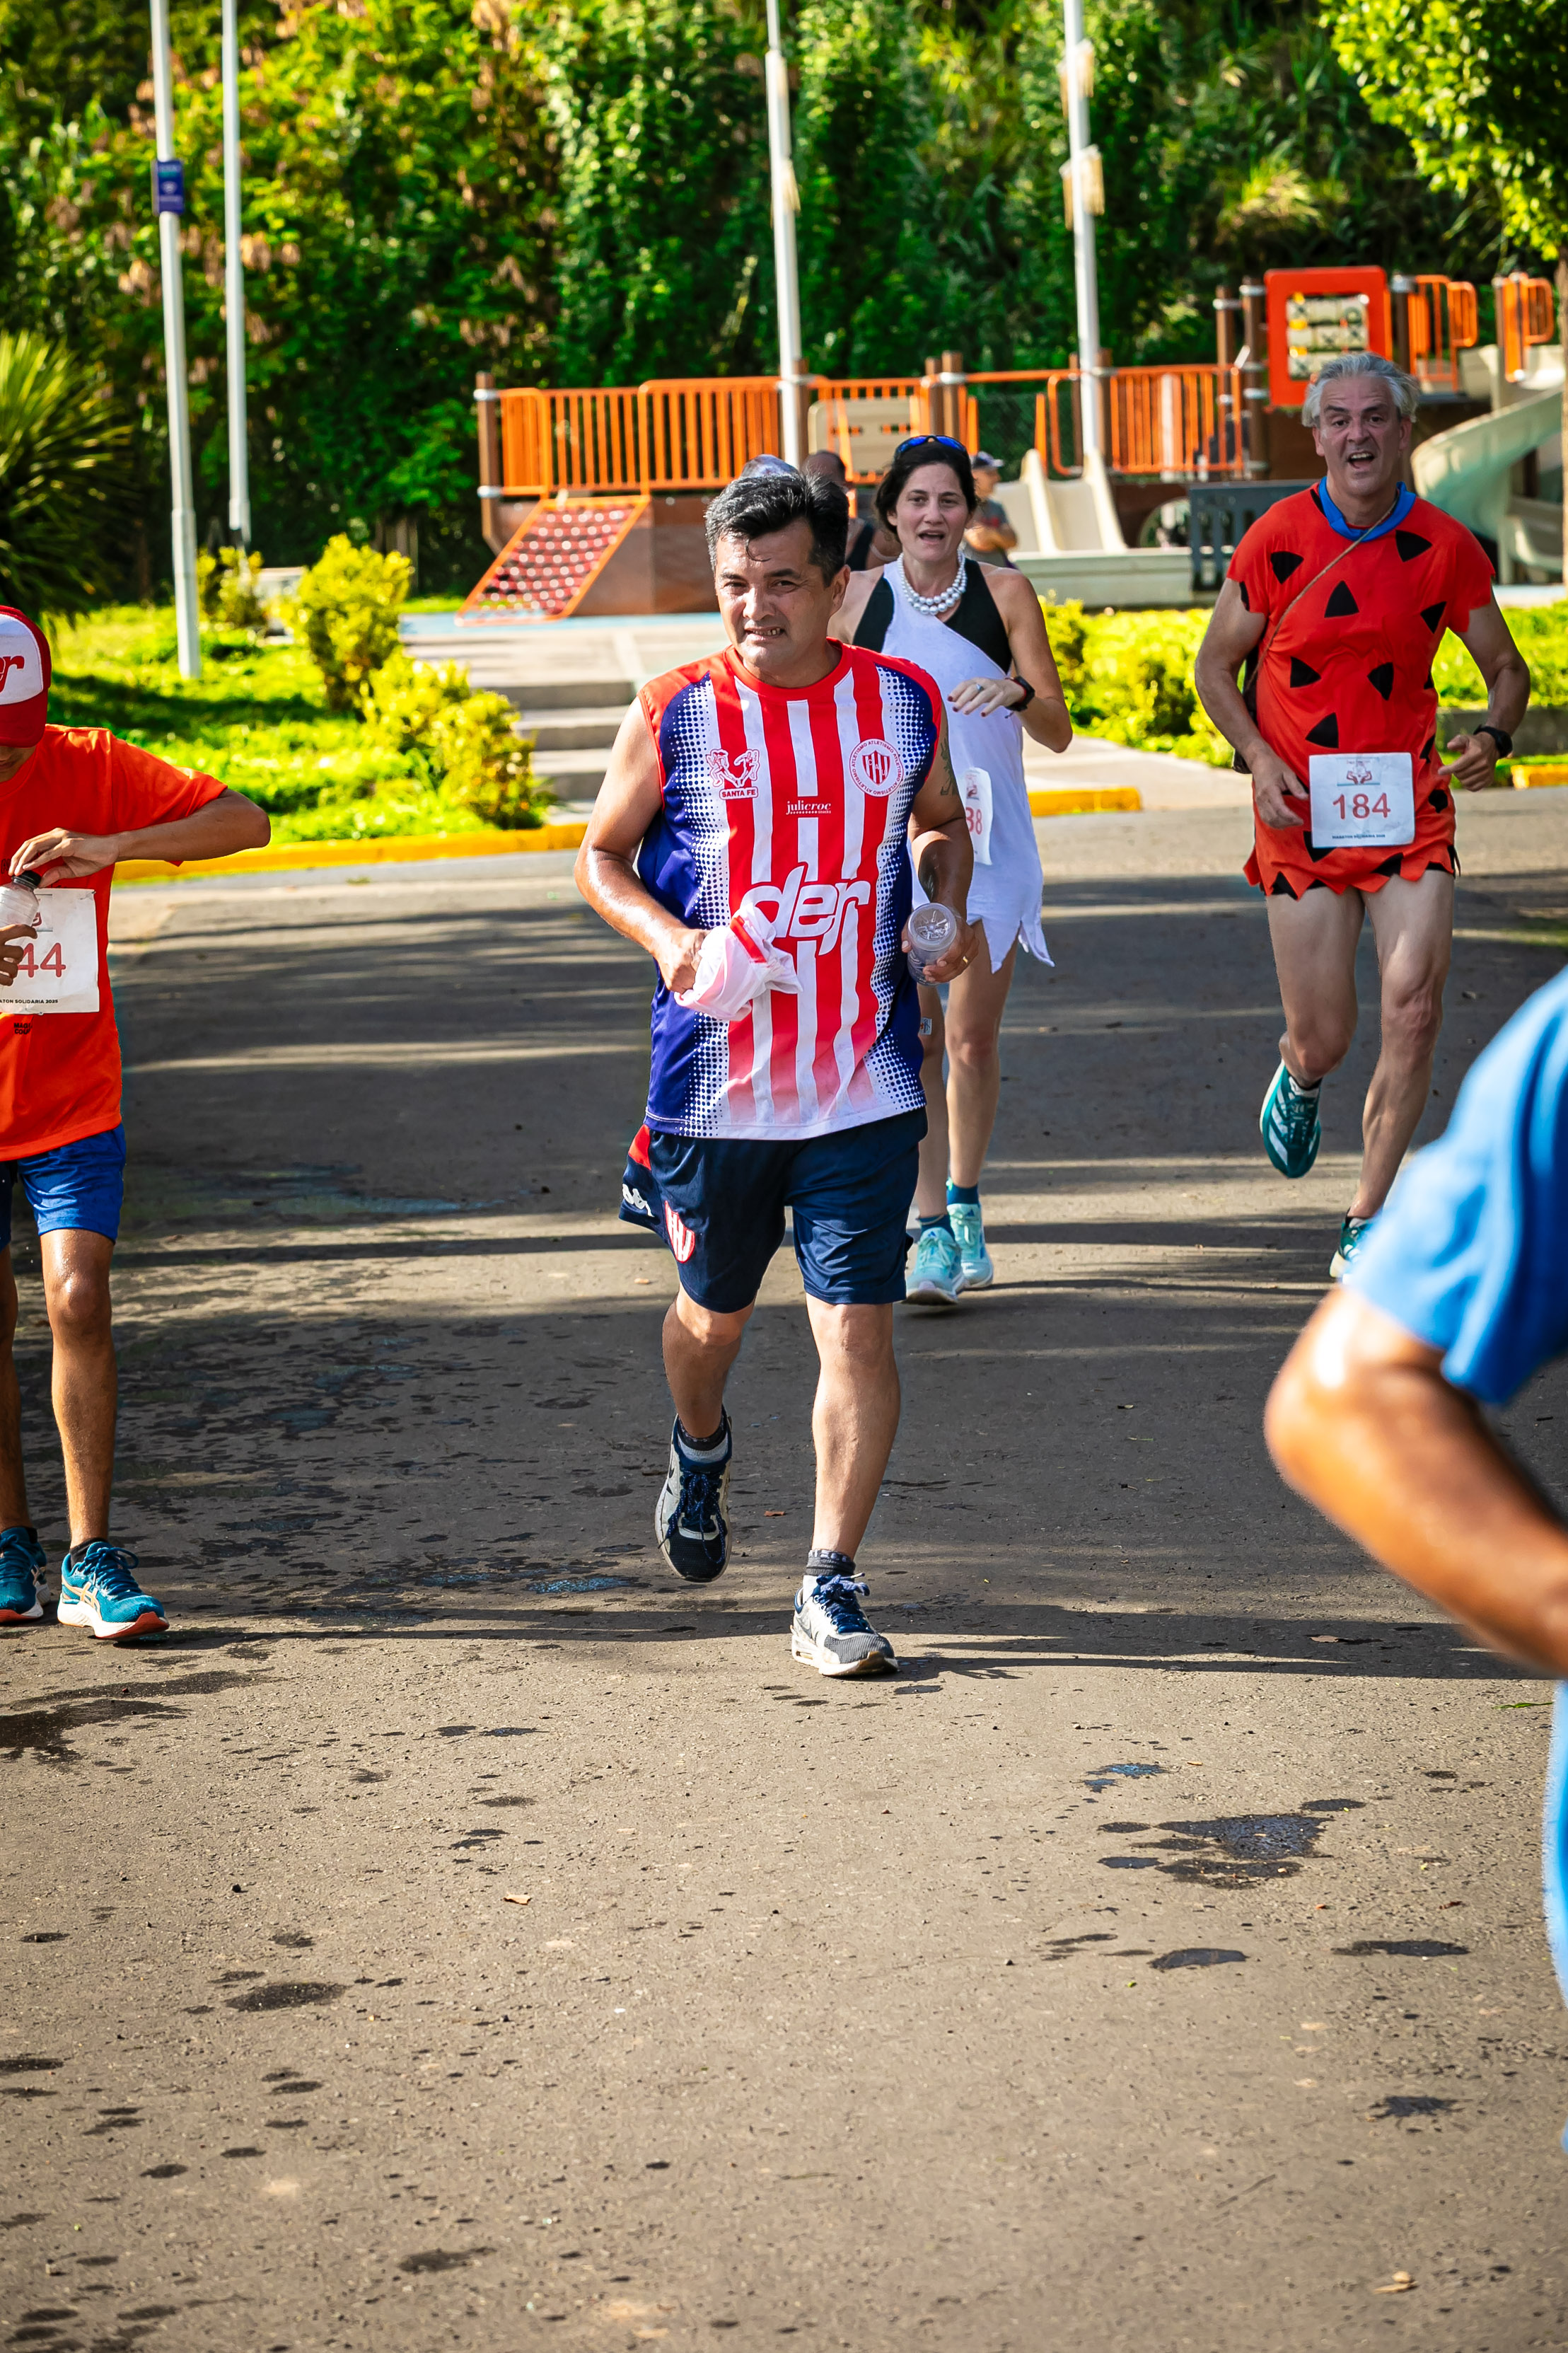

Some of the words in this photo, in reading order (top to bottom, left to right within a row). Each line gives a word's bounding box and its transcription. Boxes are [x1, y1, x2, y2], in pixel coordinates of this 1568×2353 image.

[852, 743, 867, 768] ATLETISMO
[869, 741, 893, 753] ATLETISMO
[852, 769, 872, 792] ATLETISMO
[786, 800, 831, 815] julicroc
[1333, 792, 1391, 820] 184
[740, 865, 871, 956] der
